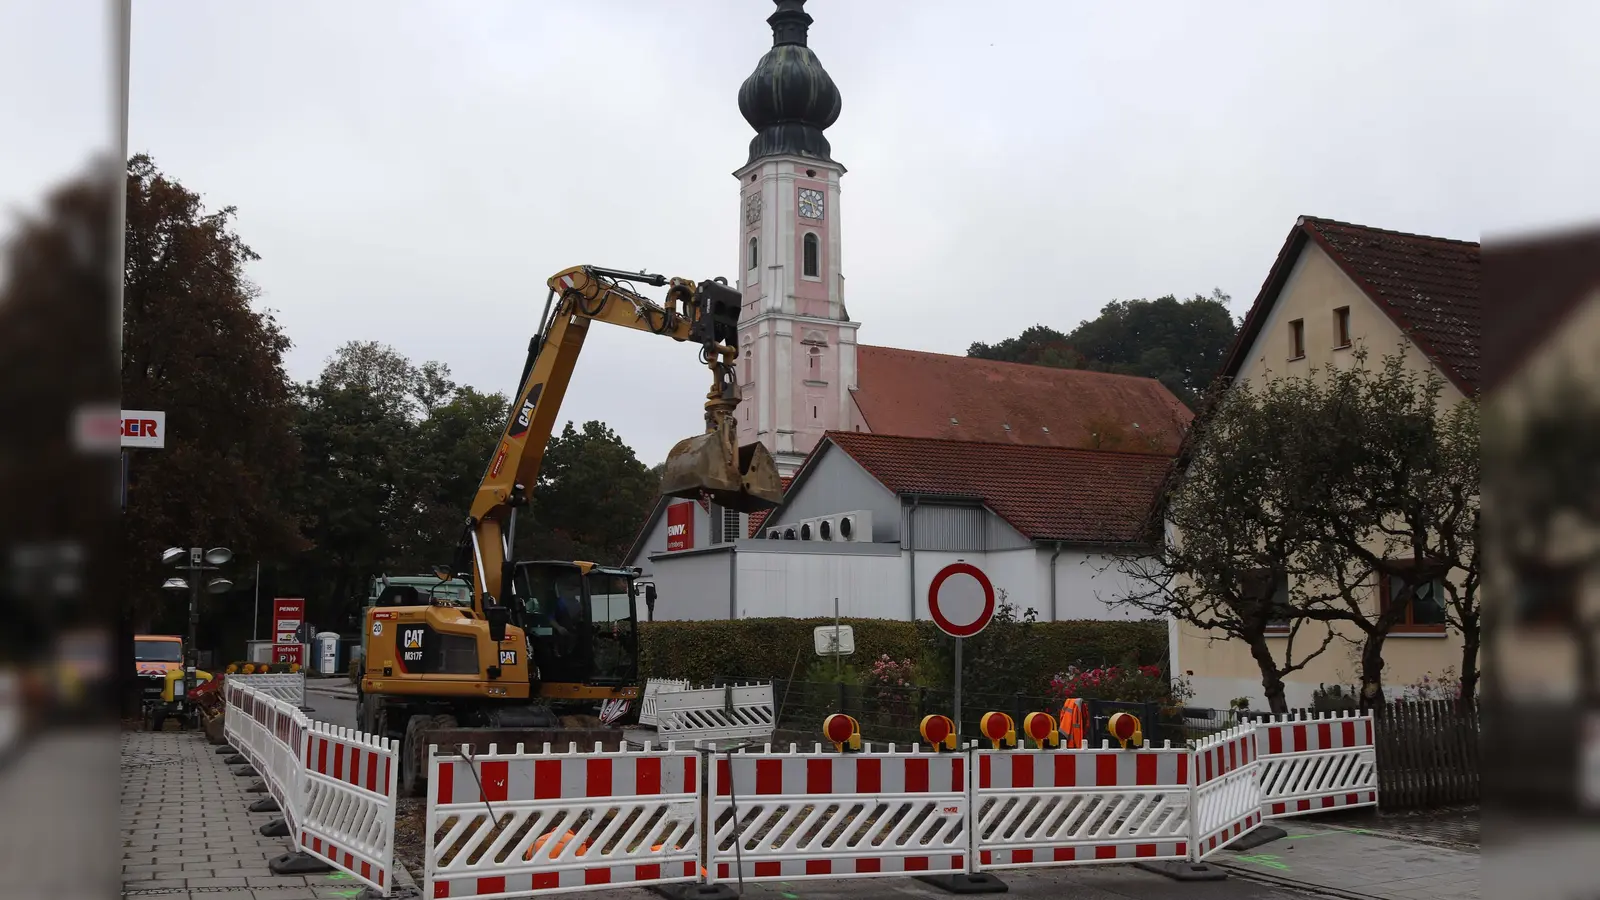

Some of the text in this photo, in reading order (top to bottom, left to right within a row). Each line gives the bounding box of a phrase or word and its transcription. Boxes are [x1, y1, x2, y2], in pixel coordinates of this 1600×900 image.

[518, 399, 535, 427] CAT
[373, 624, 382, 632] 20
[404, 629, 425, 648] CAT
[404, 651, 423, 661] M317F
[500, 651, 516, 664] CAT
